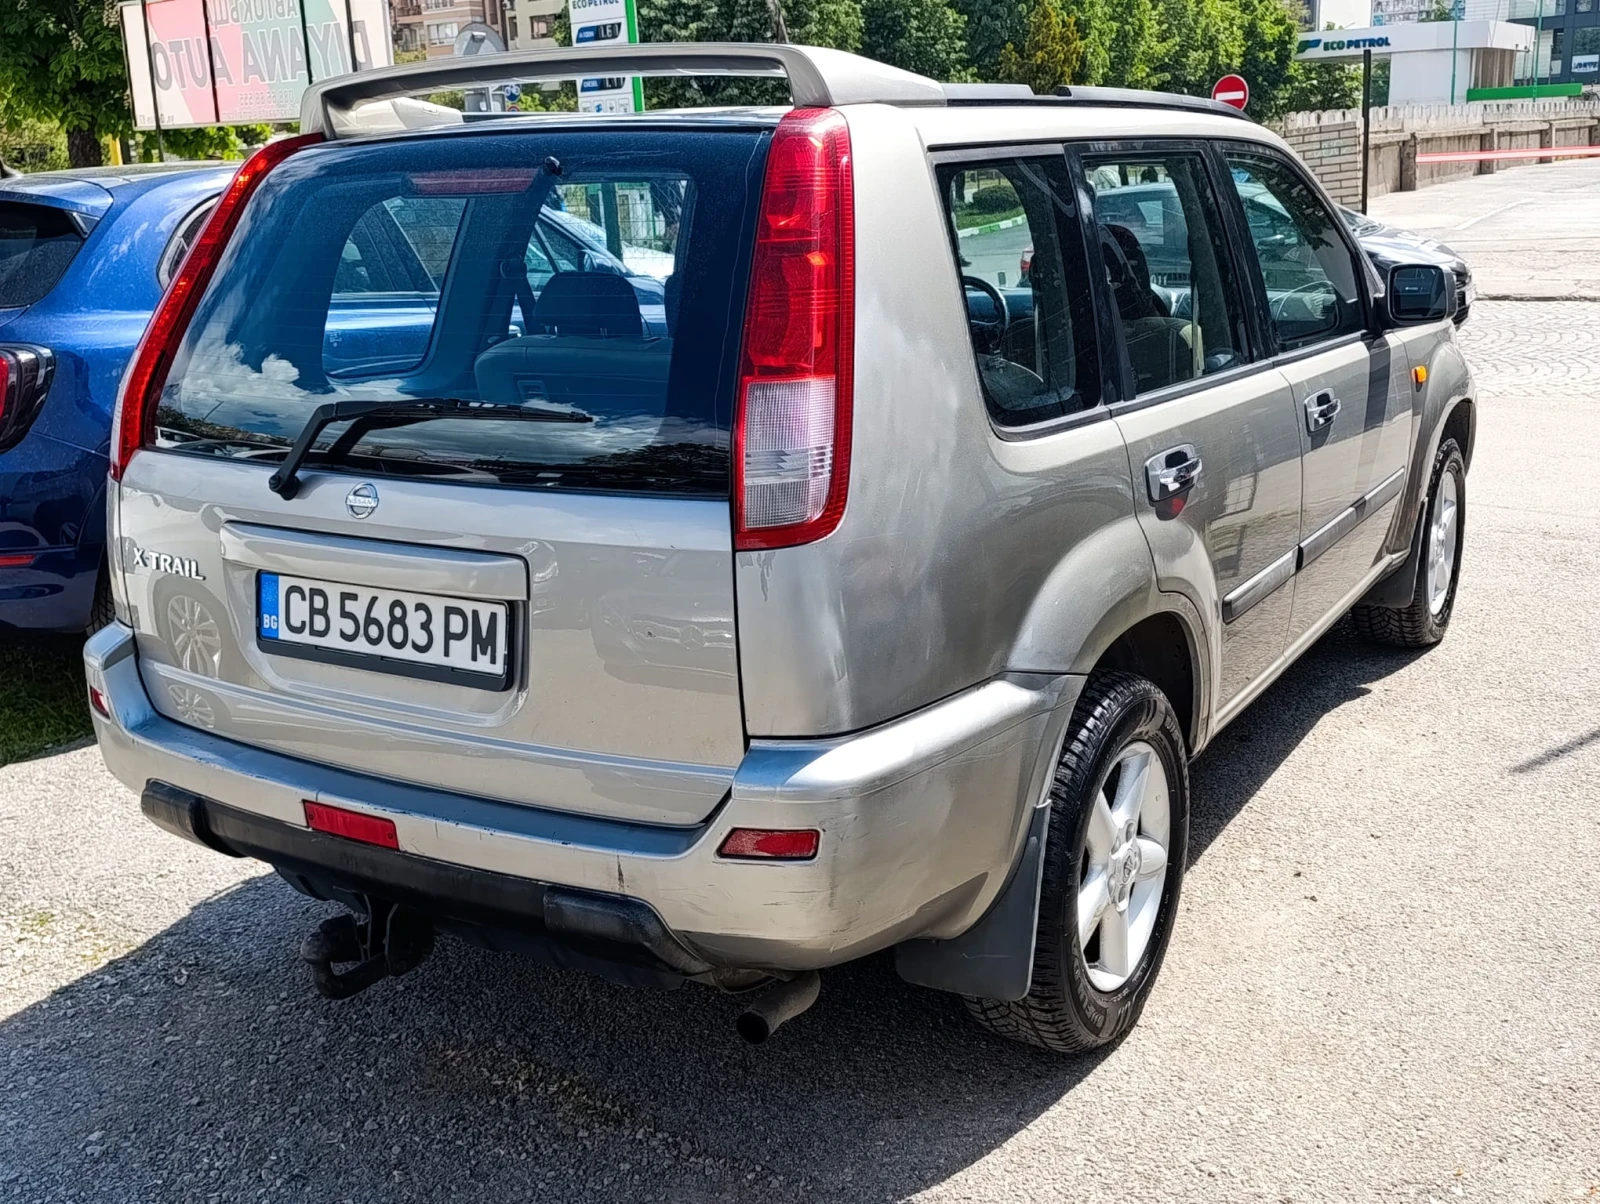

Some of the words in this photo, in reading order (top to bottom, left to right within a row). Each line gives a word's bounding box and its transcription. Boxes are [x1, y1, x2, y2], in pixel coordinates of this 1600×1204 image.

[348, 497, 373, 505] NISSAN
[133, 547, 206, 580] X-TRAIL
[263, 612, 278, 630] BG
[284, 585, 331, 638] CB
[338, 592, 434, 653] 5683
[444, 605, 498, 666] PM
